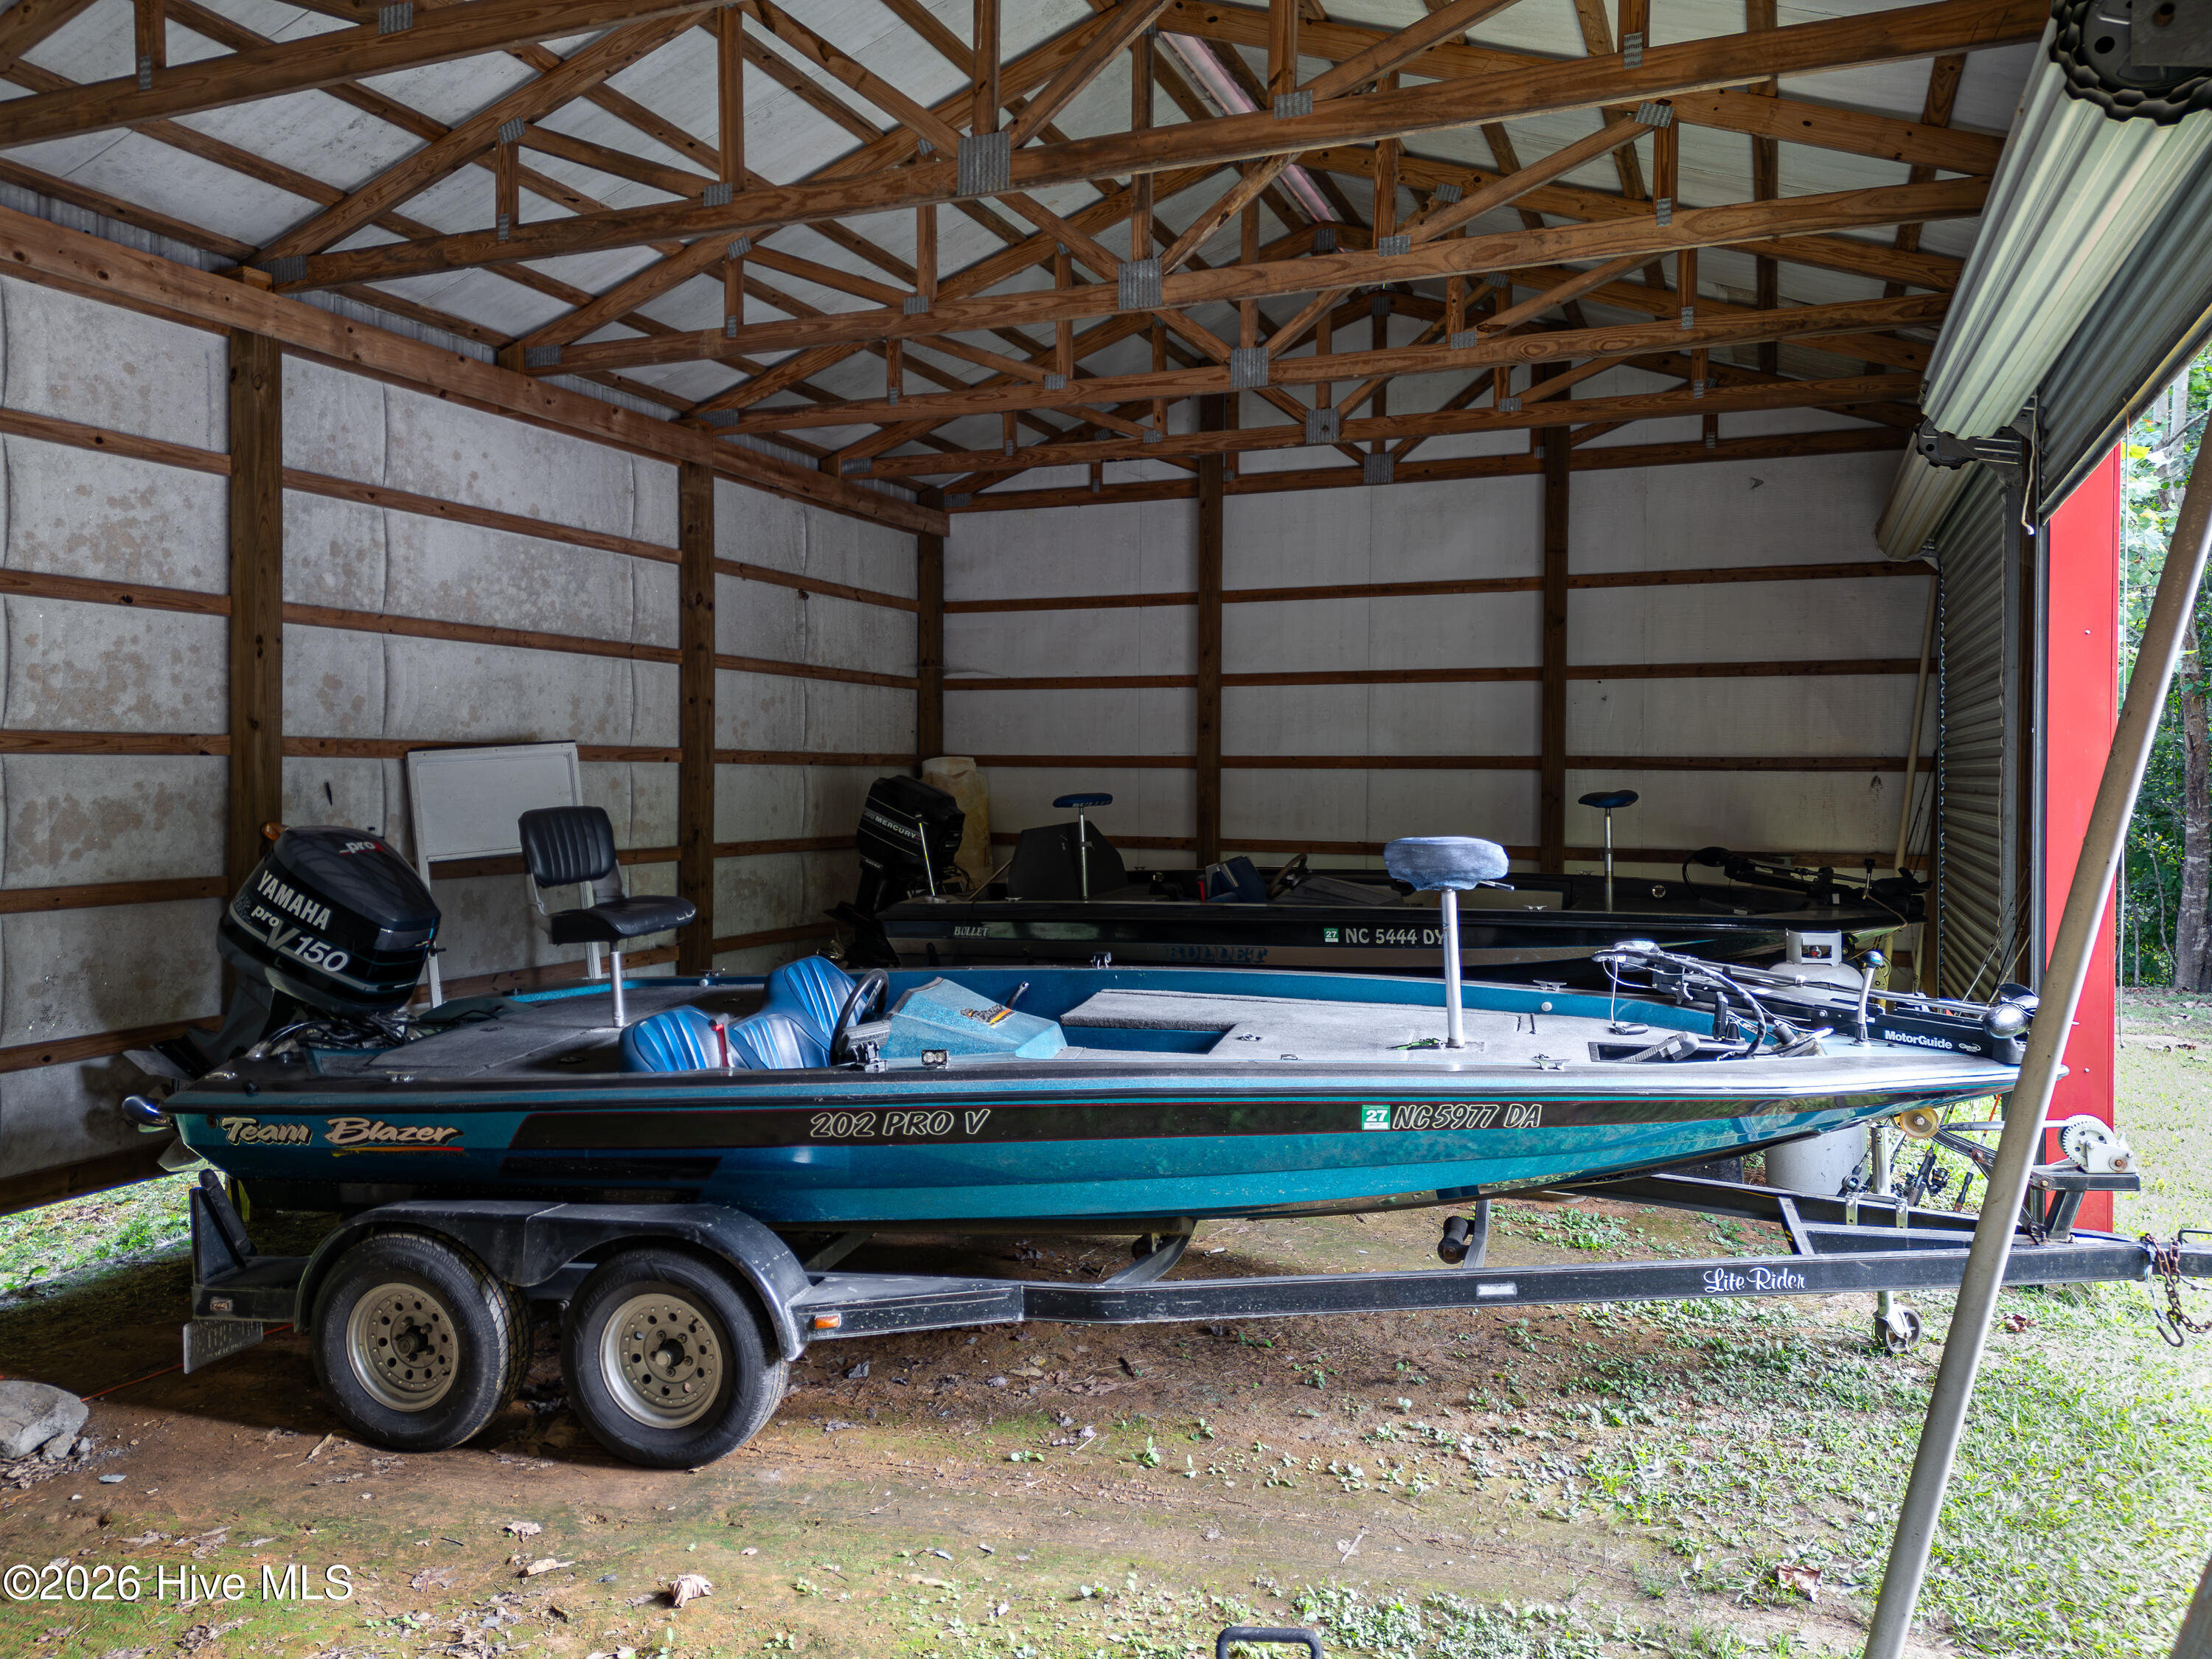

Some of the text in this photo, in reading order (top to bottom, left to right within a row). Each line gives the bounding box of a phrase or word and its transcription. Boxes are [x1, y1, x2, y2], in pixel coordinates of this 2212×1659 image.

[875, 815, 916, 838] MERCURY
[257, 870, 330, 931] YAMAHA
[954, 925, 990, 936] BULLET
[1326, 930, 1338, 938] 27
[1345, 928, 1370, 944] NC
[1375, 928, 1418, 945] 5444
[294, 936, 348, 972] 150
[1165, 945, 1269, 963] BULLET
[1885, 1029, 1953, 1050] MotorGuide
[810, 1108, 991, 1138] 202 PRO V
[1366, 1110, 1388, 1122] 27
[1503, 1104, 1543, 1128] DA
[222, 1116, 464, 1147] Team Blazer
[1703, 1267, 1805, 1293] Lite Rider
